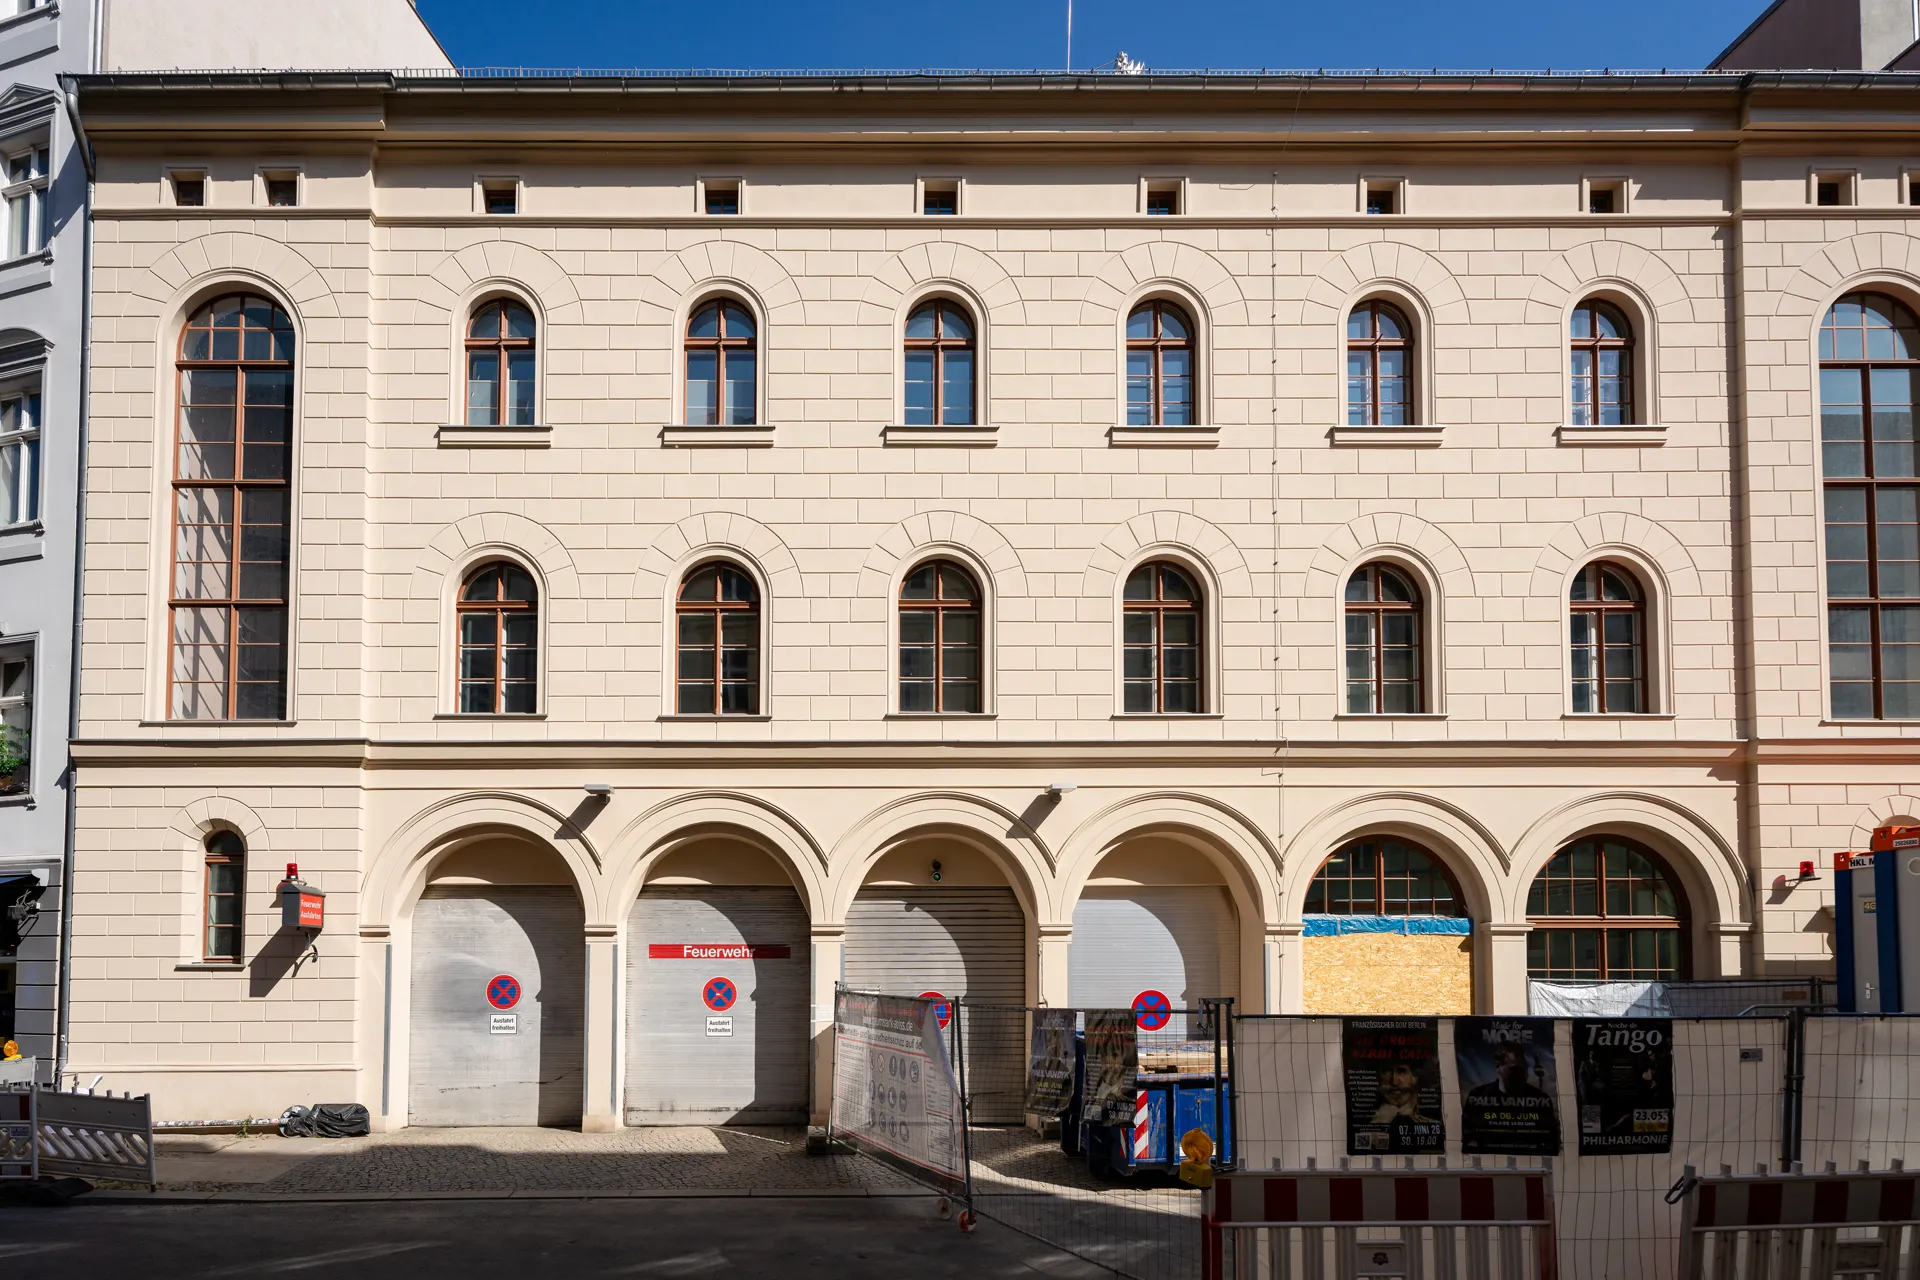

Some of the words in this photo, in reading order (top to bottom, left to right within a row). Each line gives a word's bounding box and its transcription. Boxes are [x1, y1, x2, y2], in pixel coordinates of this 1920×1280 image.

[1850, 859, 1866, 867] HKL
[301, 900, 322, 909] Feuerwehr
[301, 911, 321, 919] Ausfahrten
[684, 945, 756, 957] Feuerwehr
[1352, 1021, 1395, 1029] FRANZÖSISCHER
[1492, 1021, 1511, 1029] Made
[1513, 1021, 1524, 1030] for
[1482, 1029, 1534, 1045] MORE
[1586, 1024, 1663, 1054] Tango
[905, 1039, 915, 1048] auf
[1468, 1096, 1500, 1107] PAUL
[1484, 1112, 1497, 1120] SA
[1517, 1113, 1540, 1121] JUNI
[1636, 1112, 1666, 1120] 23.05.
[1399, 1125, 1412, 1135] 07.
[1414, 1125, 1430, 1135] JUNI
[1431, 1125, 1441, 1135] 26
[1417, 1137, 1437, 1146] 19.00
[1583, 1134, 1668, 1146] PHILHARMONIE
